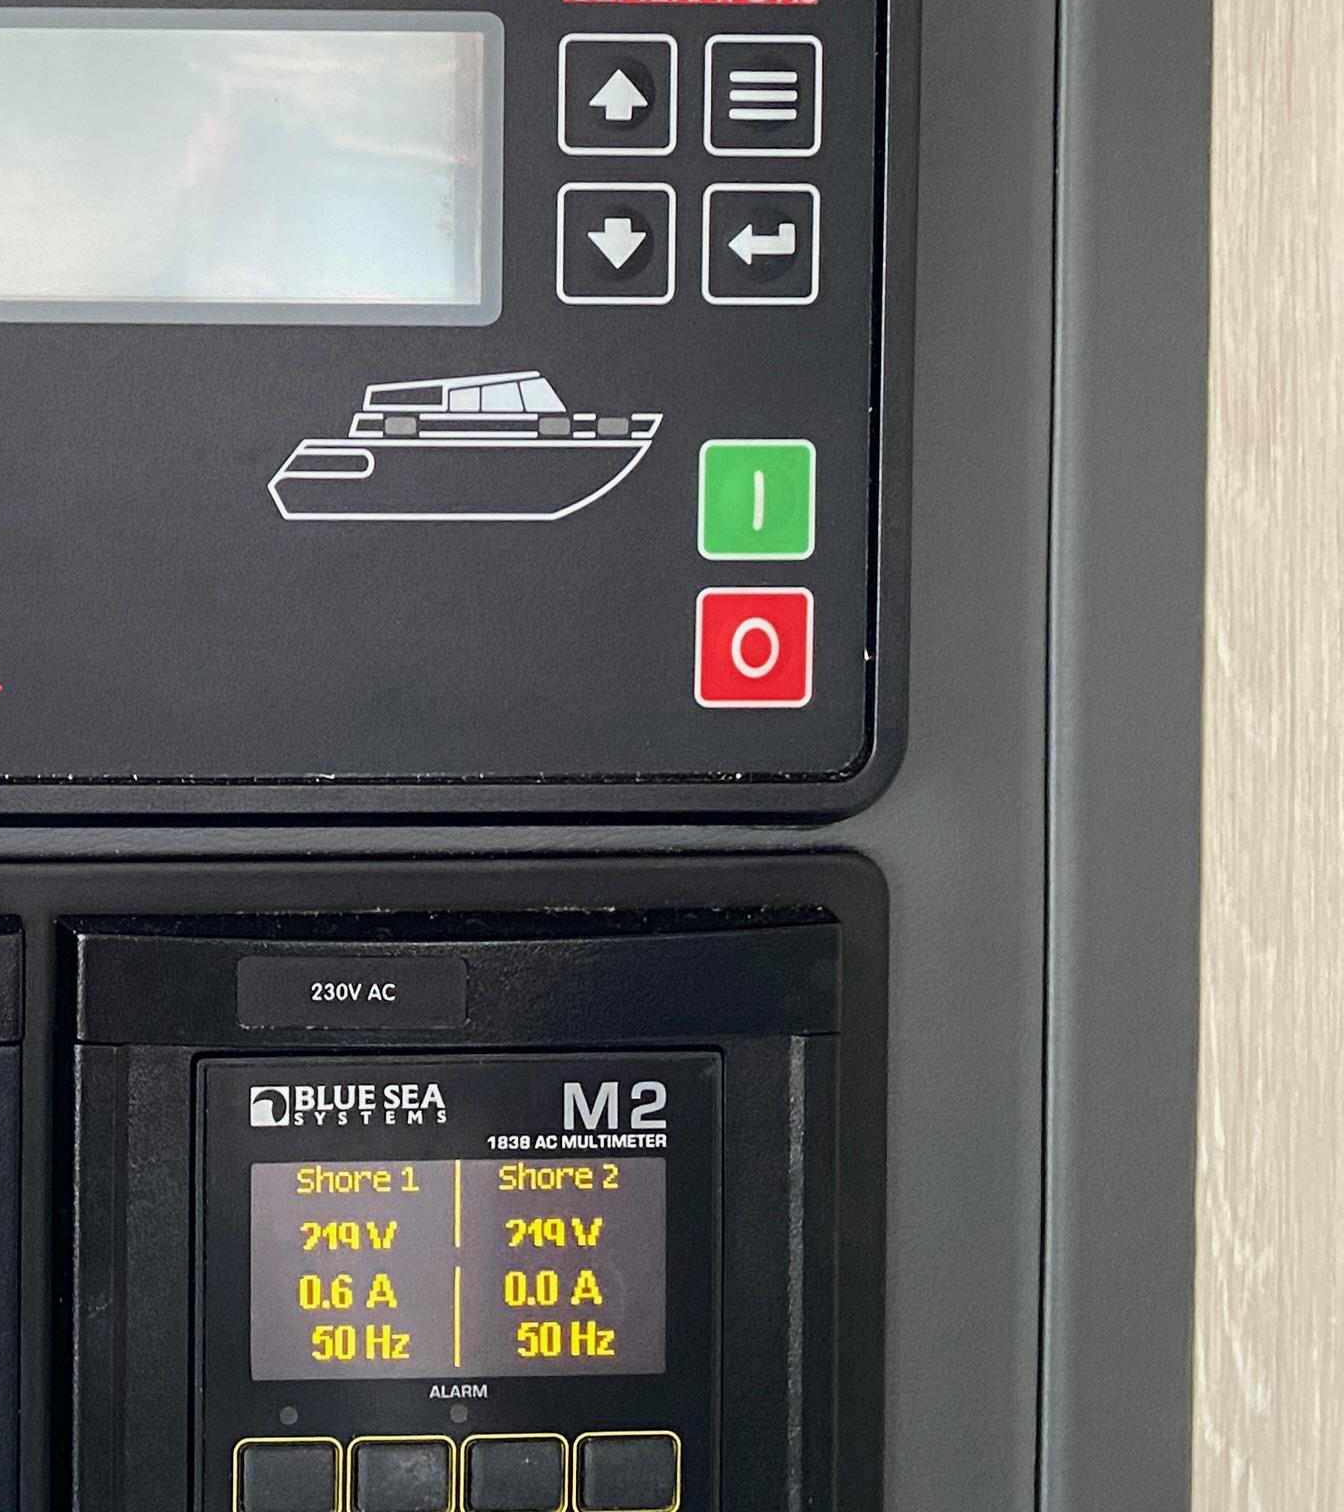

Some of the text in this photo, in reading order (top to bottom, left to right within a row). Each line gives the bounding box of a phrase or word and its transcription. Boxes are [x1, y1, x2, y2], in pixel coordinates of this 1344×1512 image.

[311, 982, 396, 1001] 230V AC
[487, 1133, 667, 1150] 1838 AC MULTIMETER
[296, 1165, 420, 1197] Shore 1
[310, 1324, 410, 1362] 50 Hz
